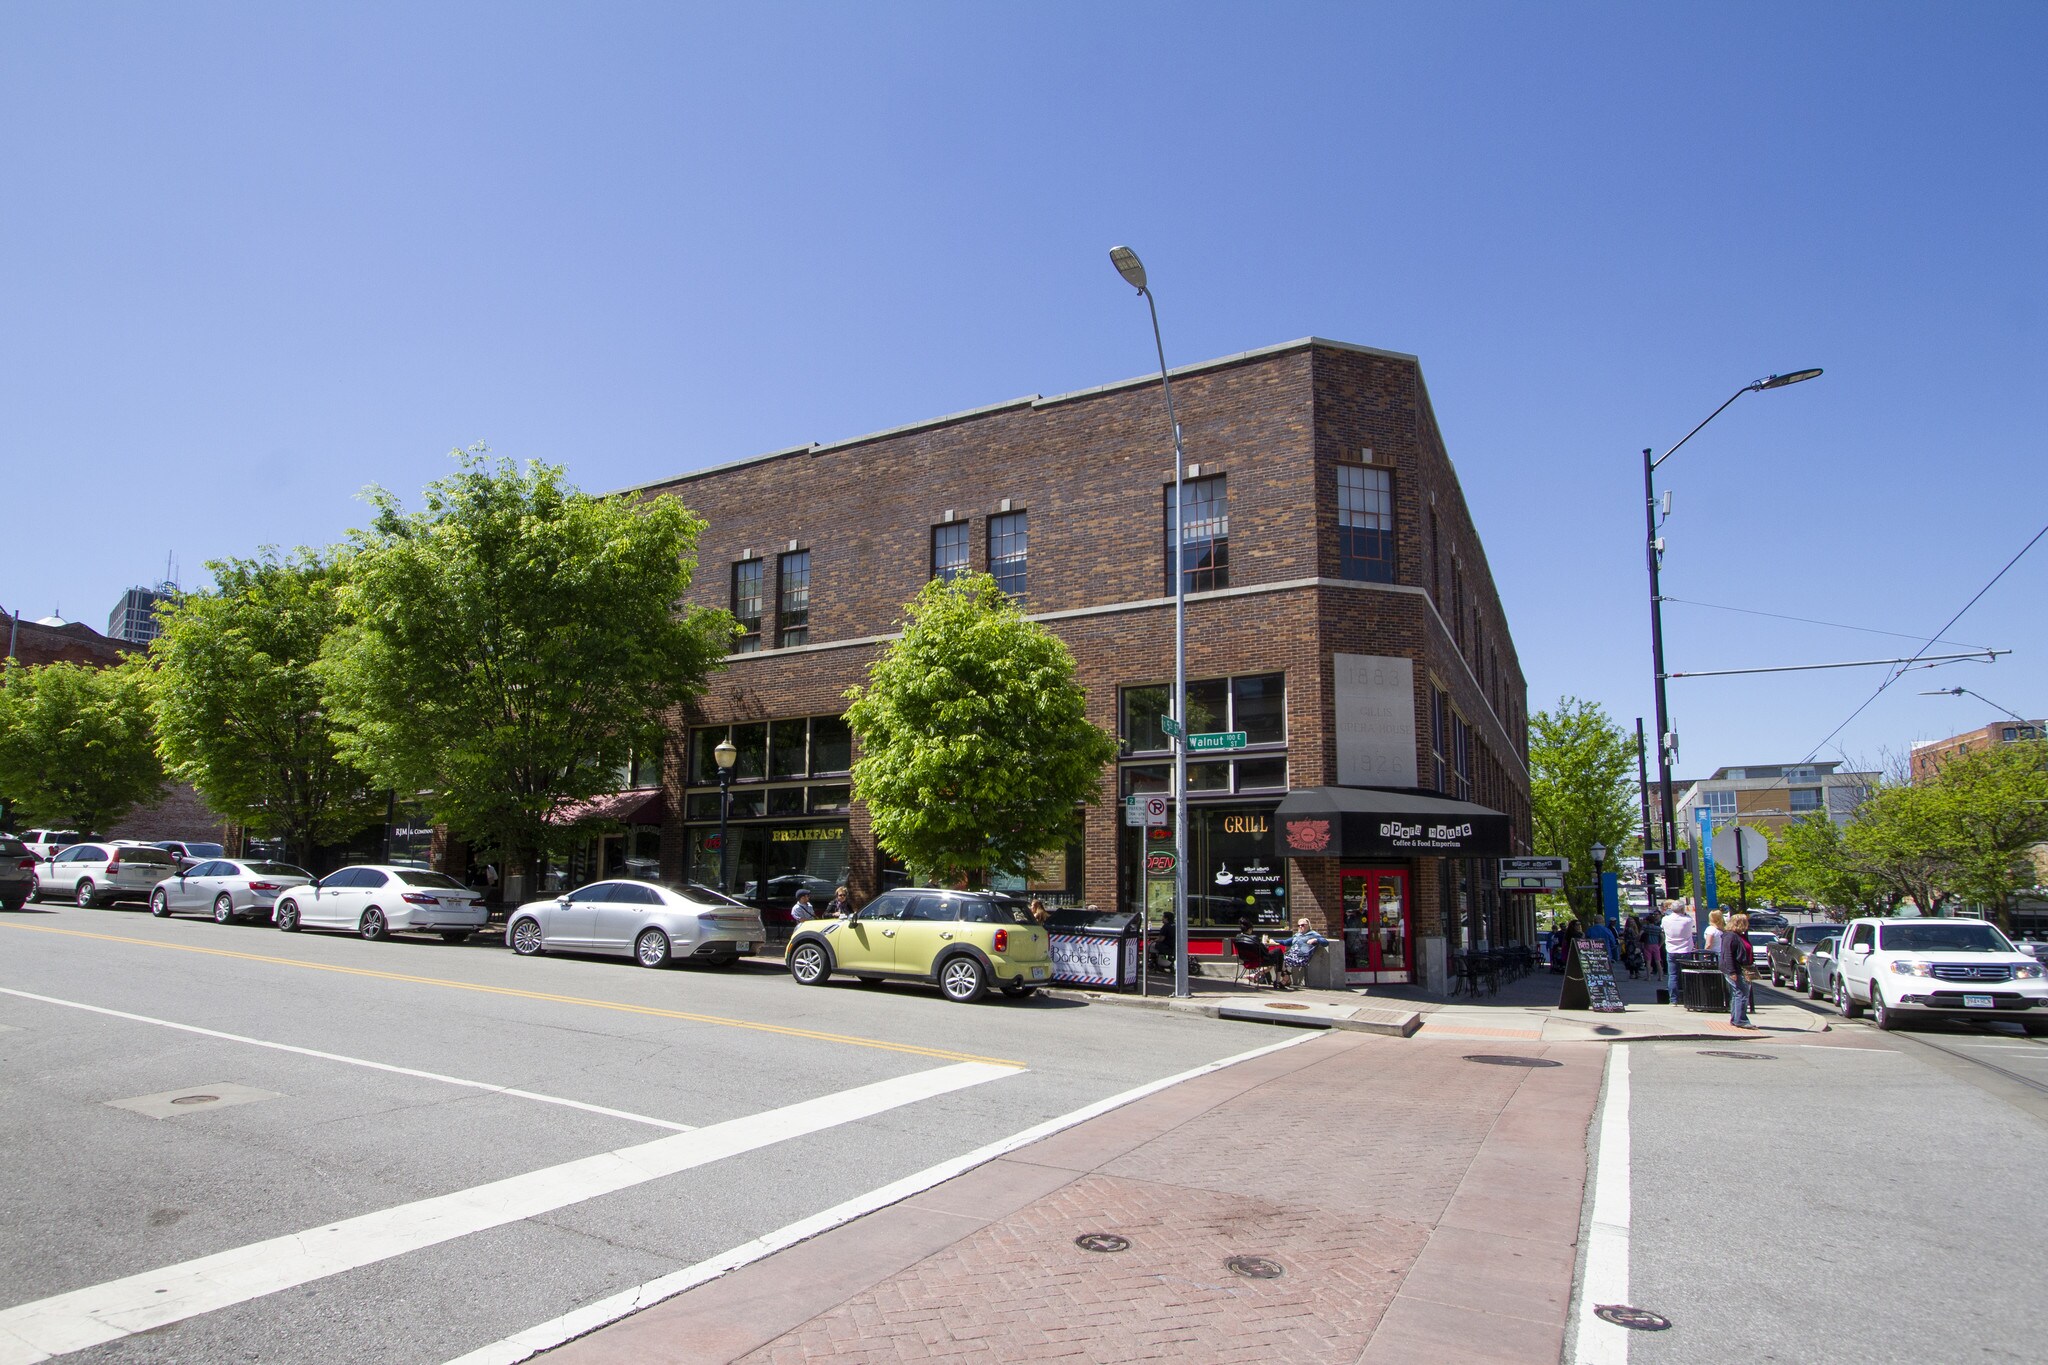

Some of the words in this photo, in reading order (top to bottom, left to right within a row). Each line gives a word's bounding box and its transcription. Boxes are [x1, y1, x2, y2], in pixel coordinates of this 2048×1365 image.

[1348, 667, 1400, 687] 1883
[1189, 736, 1224, 747] Walnut
[1351, 754, 1403, 773] 1926
[1224, 815, 1269, 833] GRILL
[1380, 821, 1422, 839] Opera
[1428, 823, 1473, 840] House
[772, 828, 844, 841] BREAKFAST
[1432, 840, 1461, 848] Emporium
[1051, 945, 1111, 966] Barberelle
